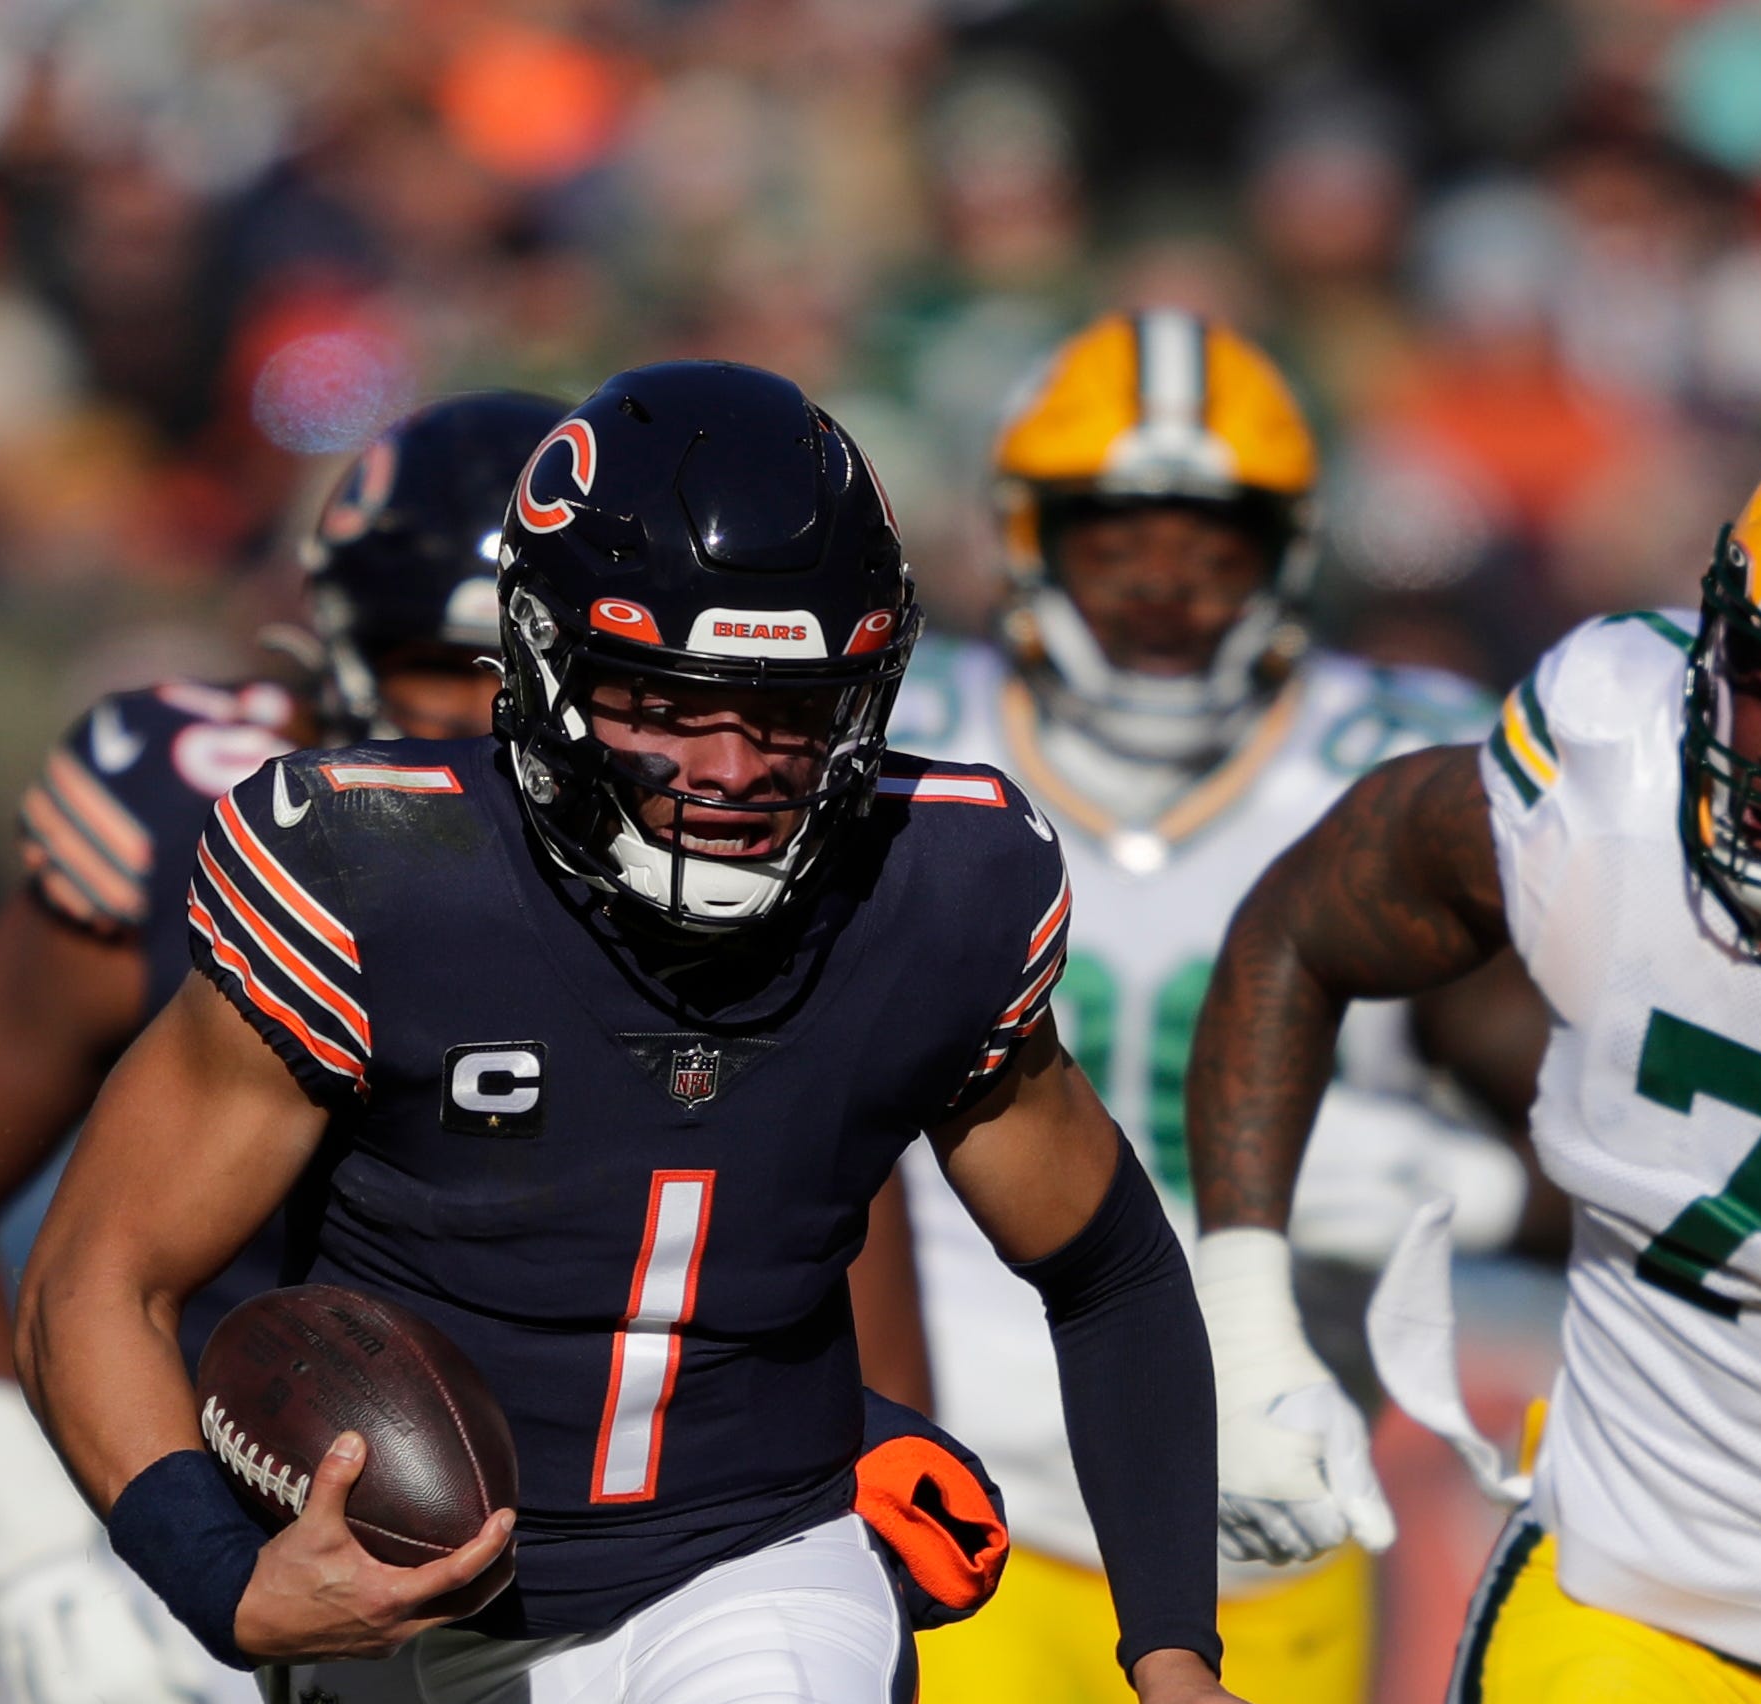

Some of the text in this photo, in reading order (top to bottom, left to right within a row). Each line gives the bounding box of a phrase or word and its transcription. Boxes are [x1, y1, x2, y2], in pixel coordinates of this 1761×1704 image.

[516, 417, 597, 534] C
[712, 620, 808, 642] BEARS
[451, 1050, 540, 1114] C
[674, 1071, 713, 1099] NFL
[590, 1169, 717, 1505] 1
